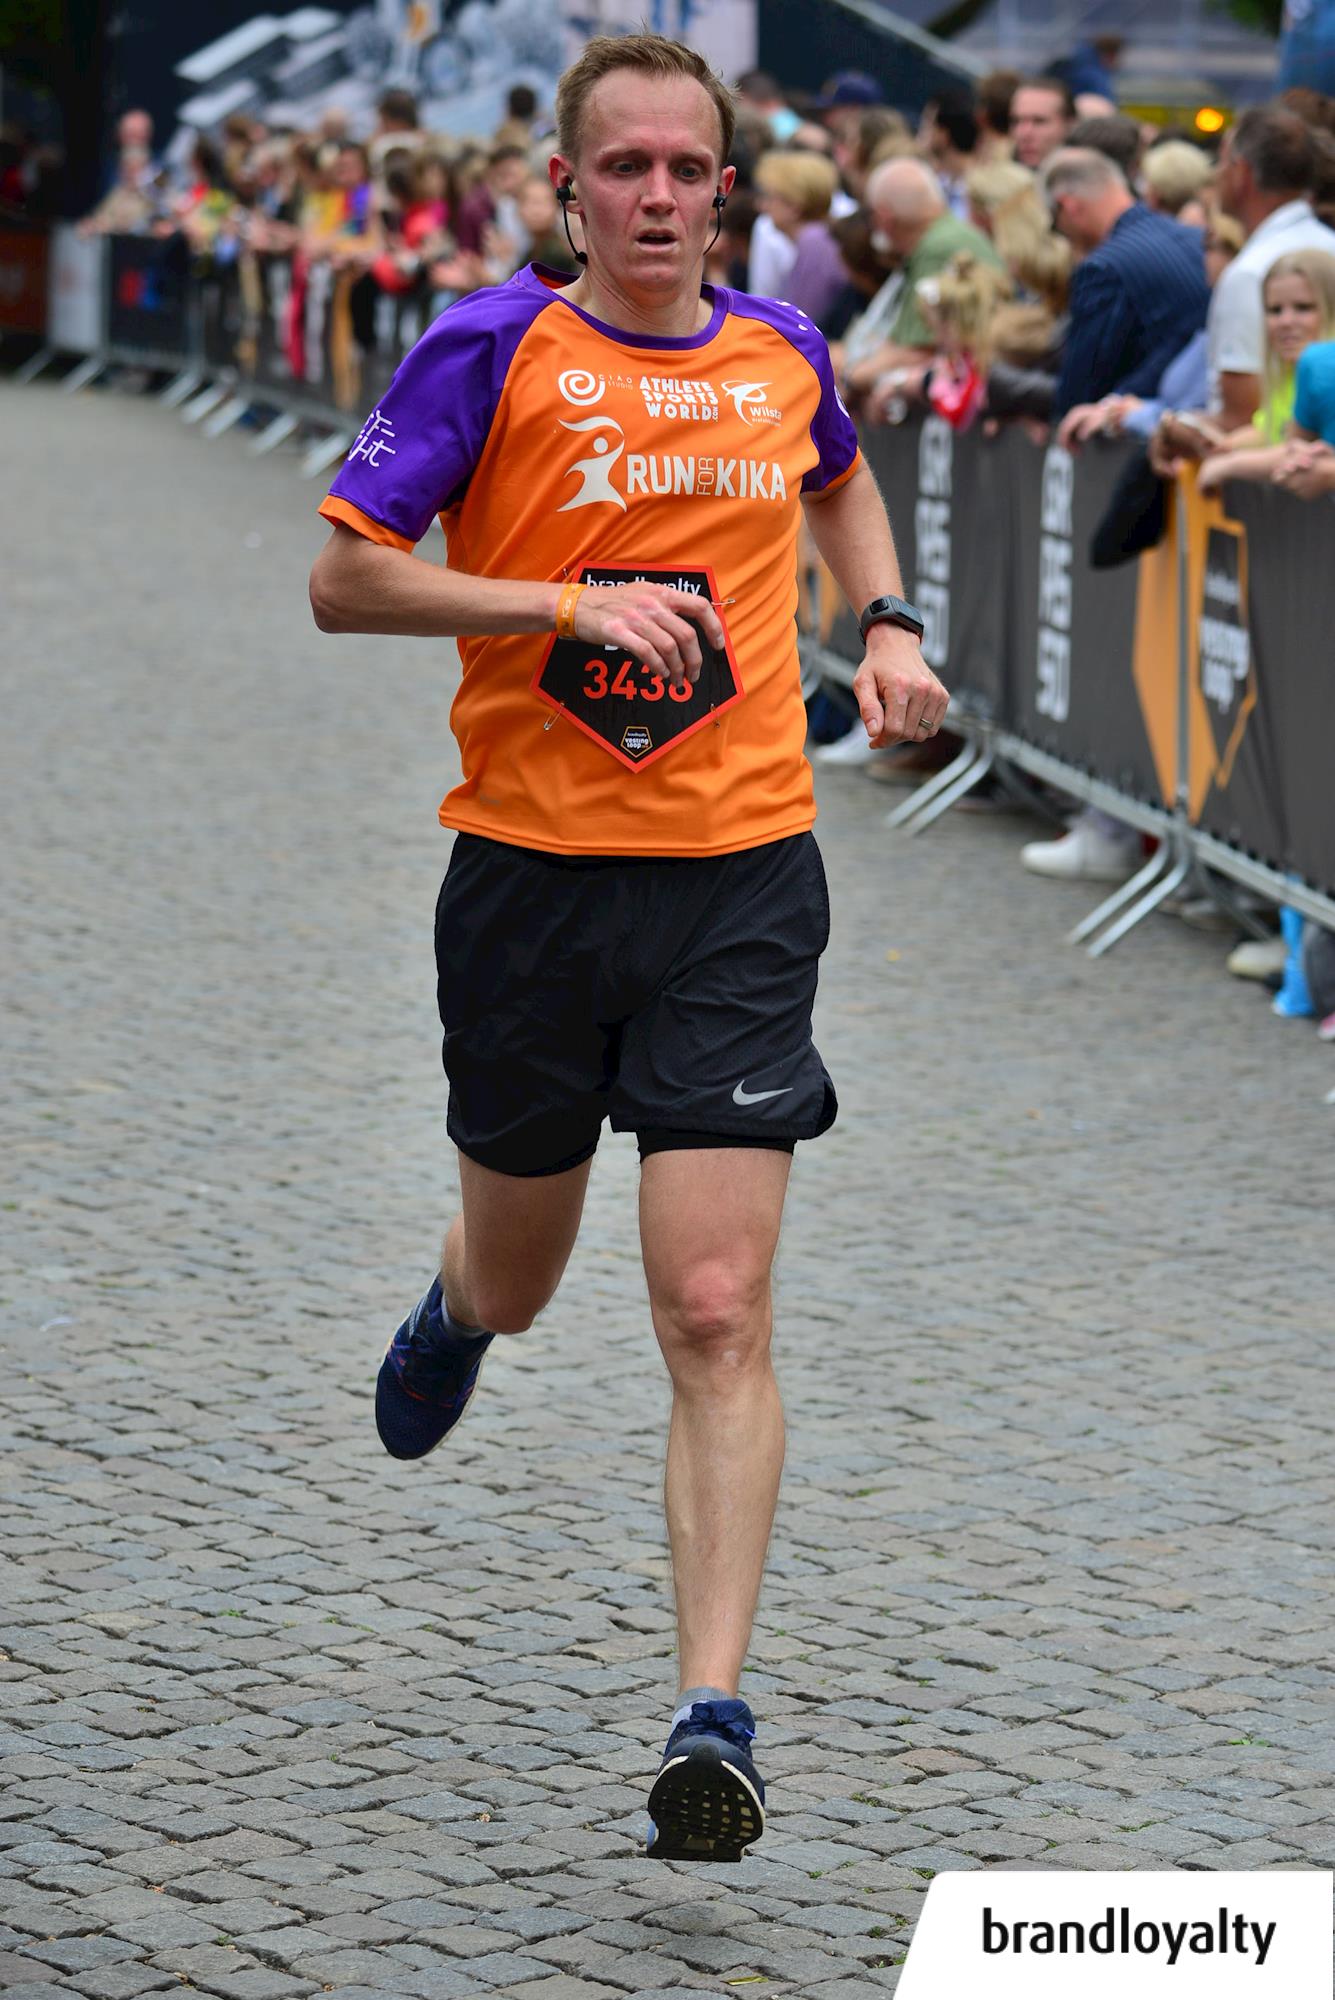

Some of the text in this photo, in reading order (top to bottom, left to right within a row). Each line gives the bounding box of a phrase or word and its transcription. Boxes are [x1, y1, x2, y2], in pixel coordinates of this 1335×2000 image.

[639, 376, 714, 394] ATHLETE
[641, 390, 719, 405] SPORTS
[645, 402, 712, 421] WORLD
[627, 454, 787, 501] RUN FOR KIKA
